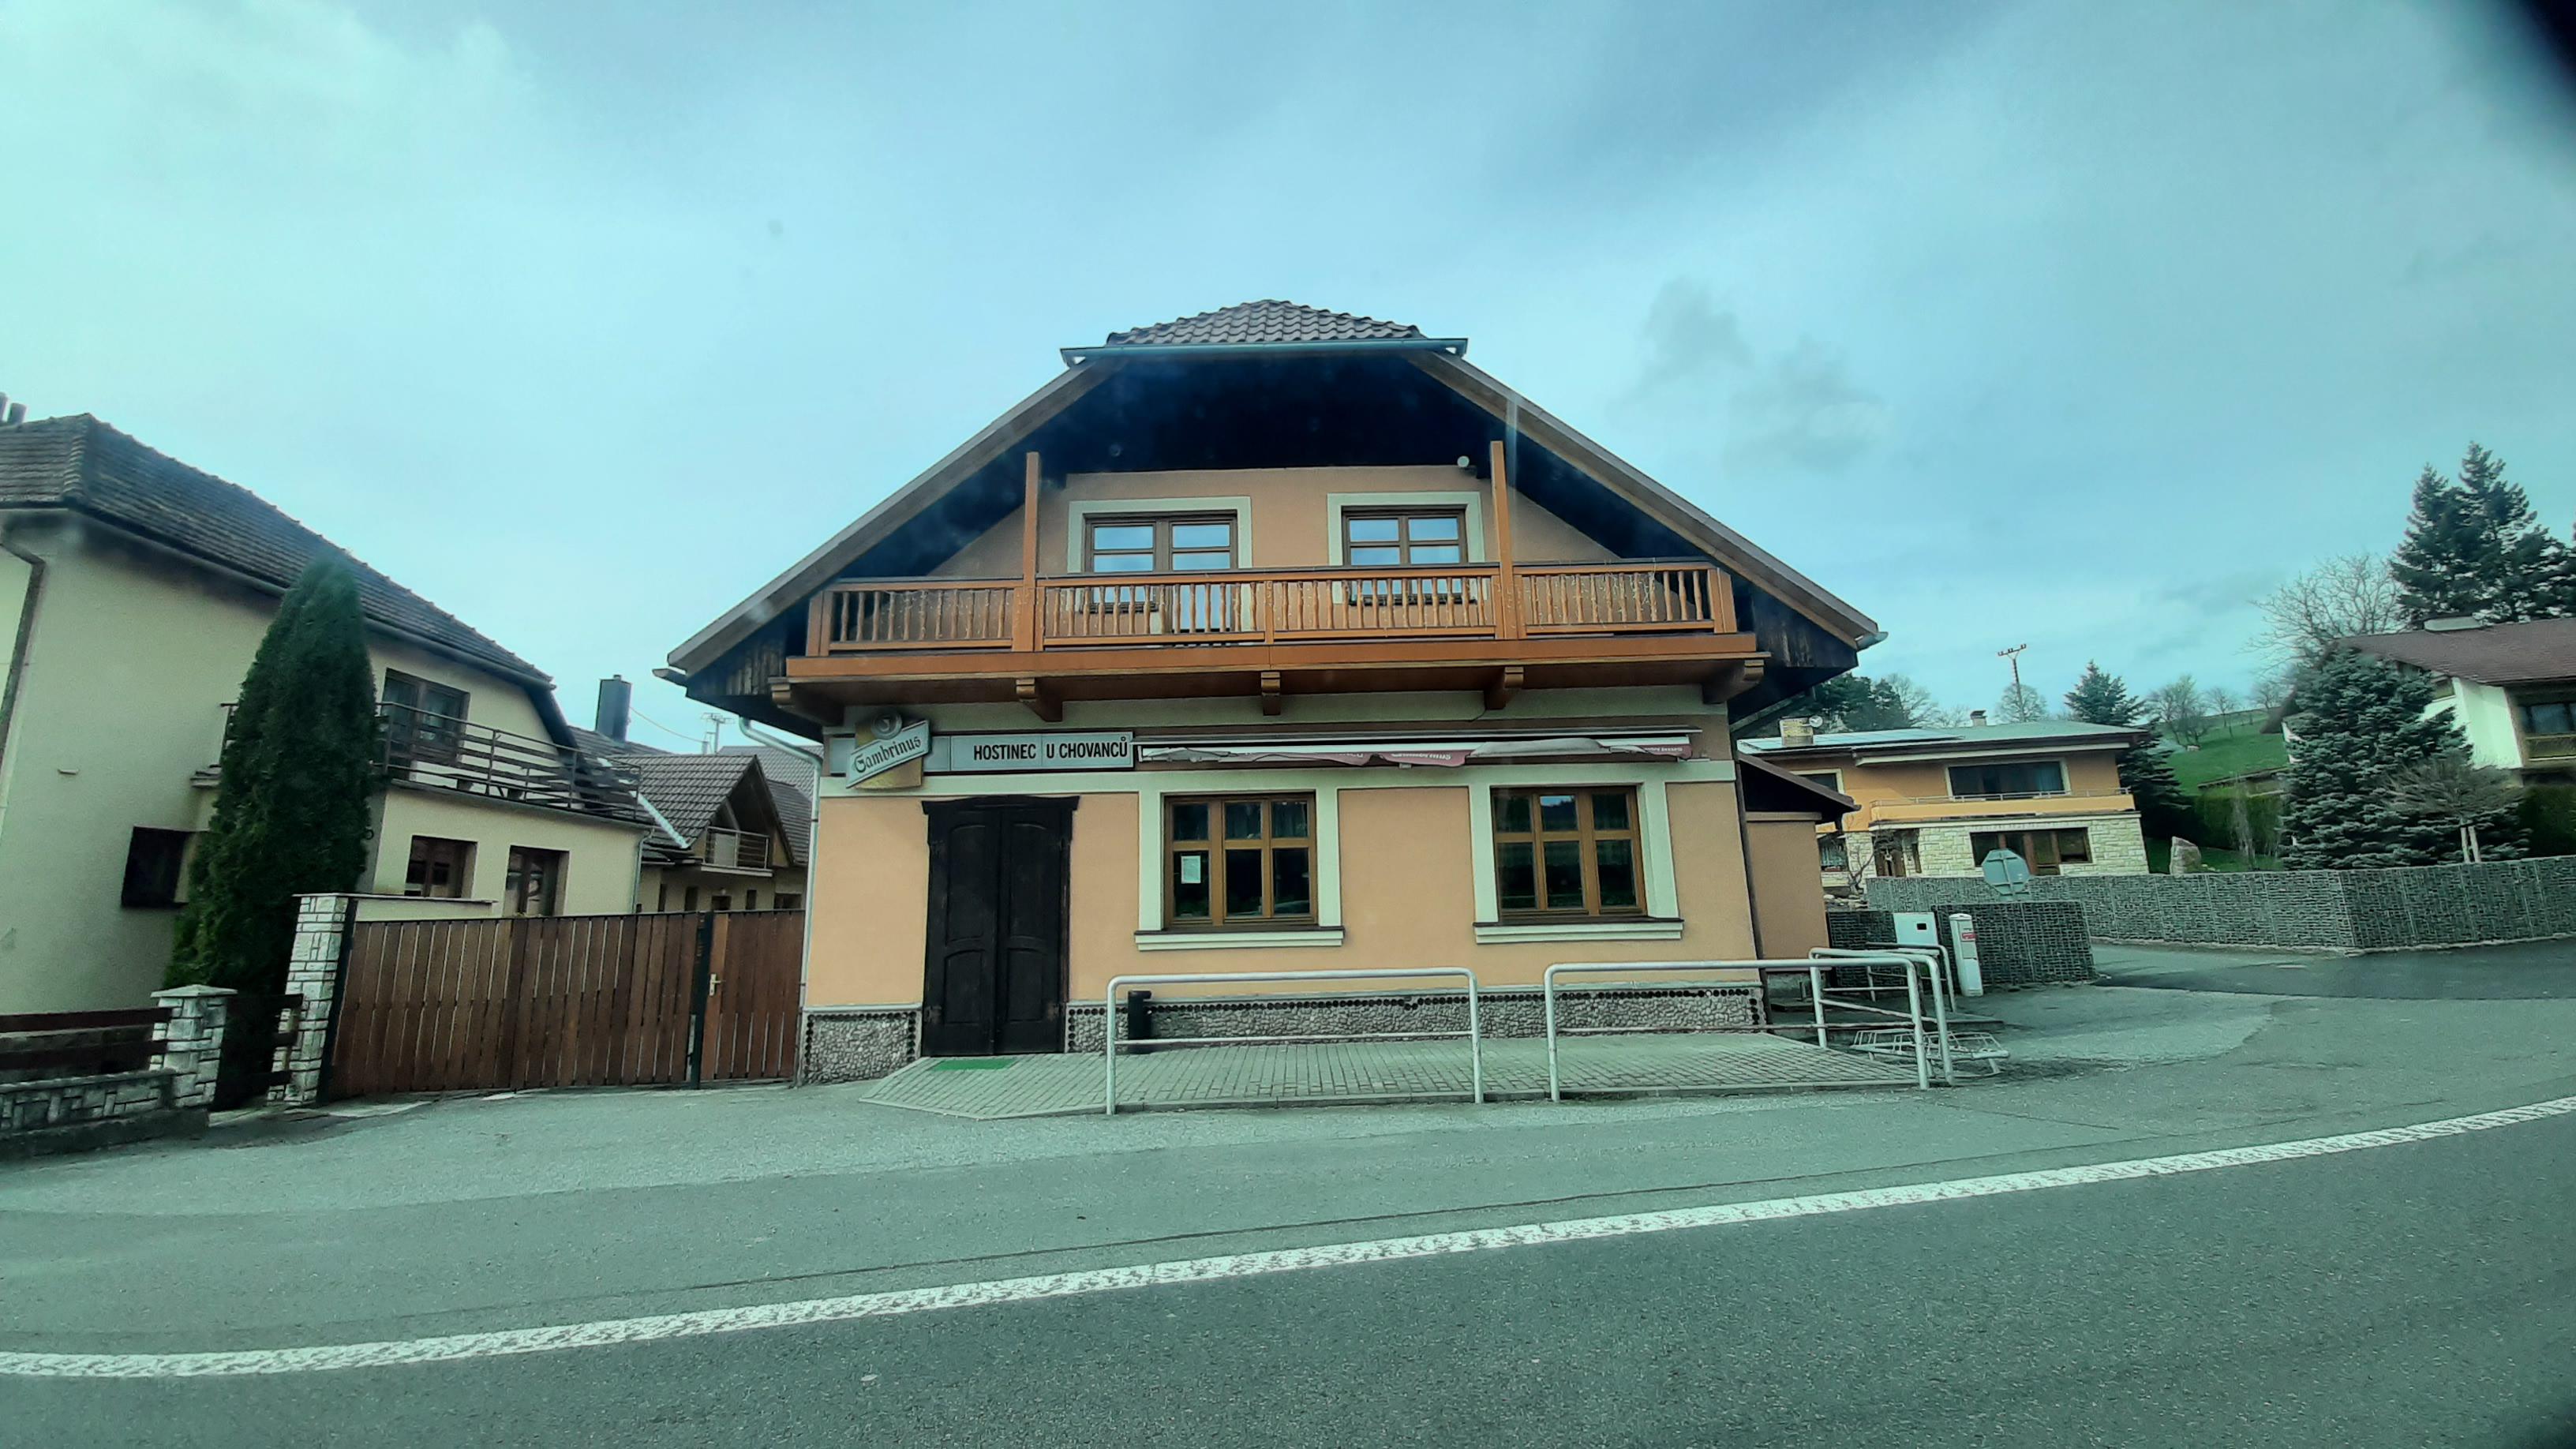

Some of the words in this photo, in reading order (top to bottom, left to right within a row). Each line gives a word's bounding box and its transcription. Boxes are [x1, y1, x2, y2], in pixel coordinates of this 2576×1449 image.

[853, 736, 922, 773] Gambrinus
[973, 743, 1037, 761] HOSTINEC
[1046, 743, 1055, 759] U
[1058, 736, 1129, 758] CHOVANCŮ
